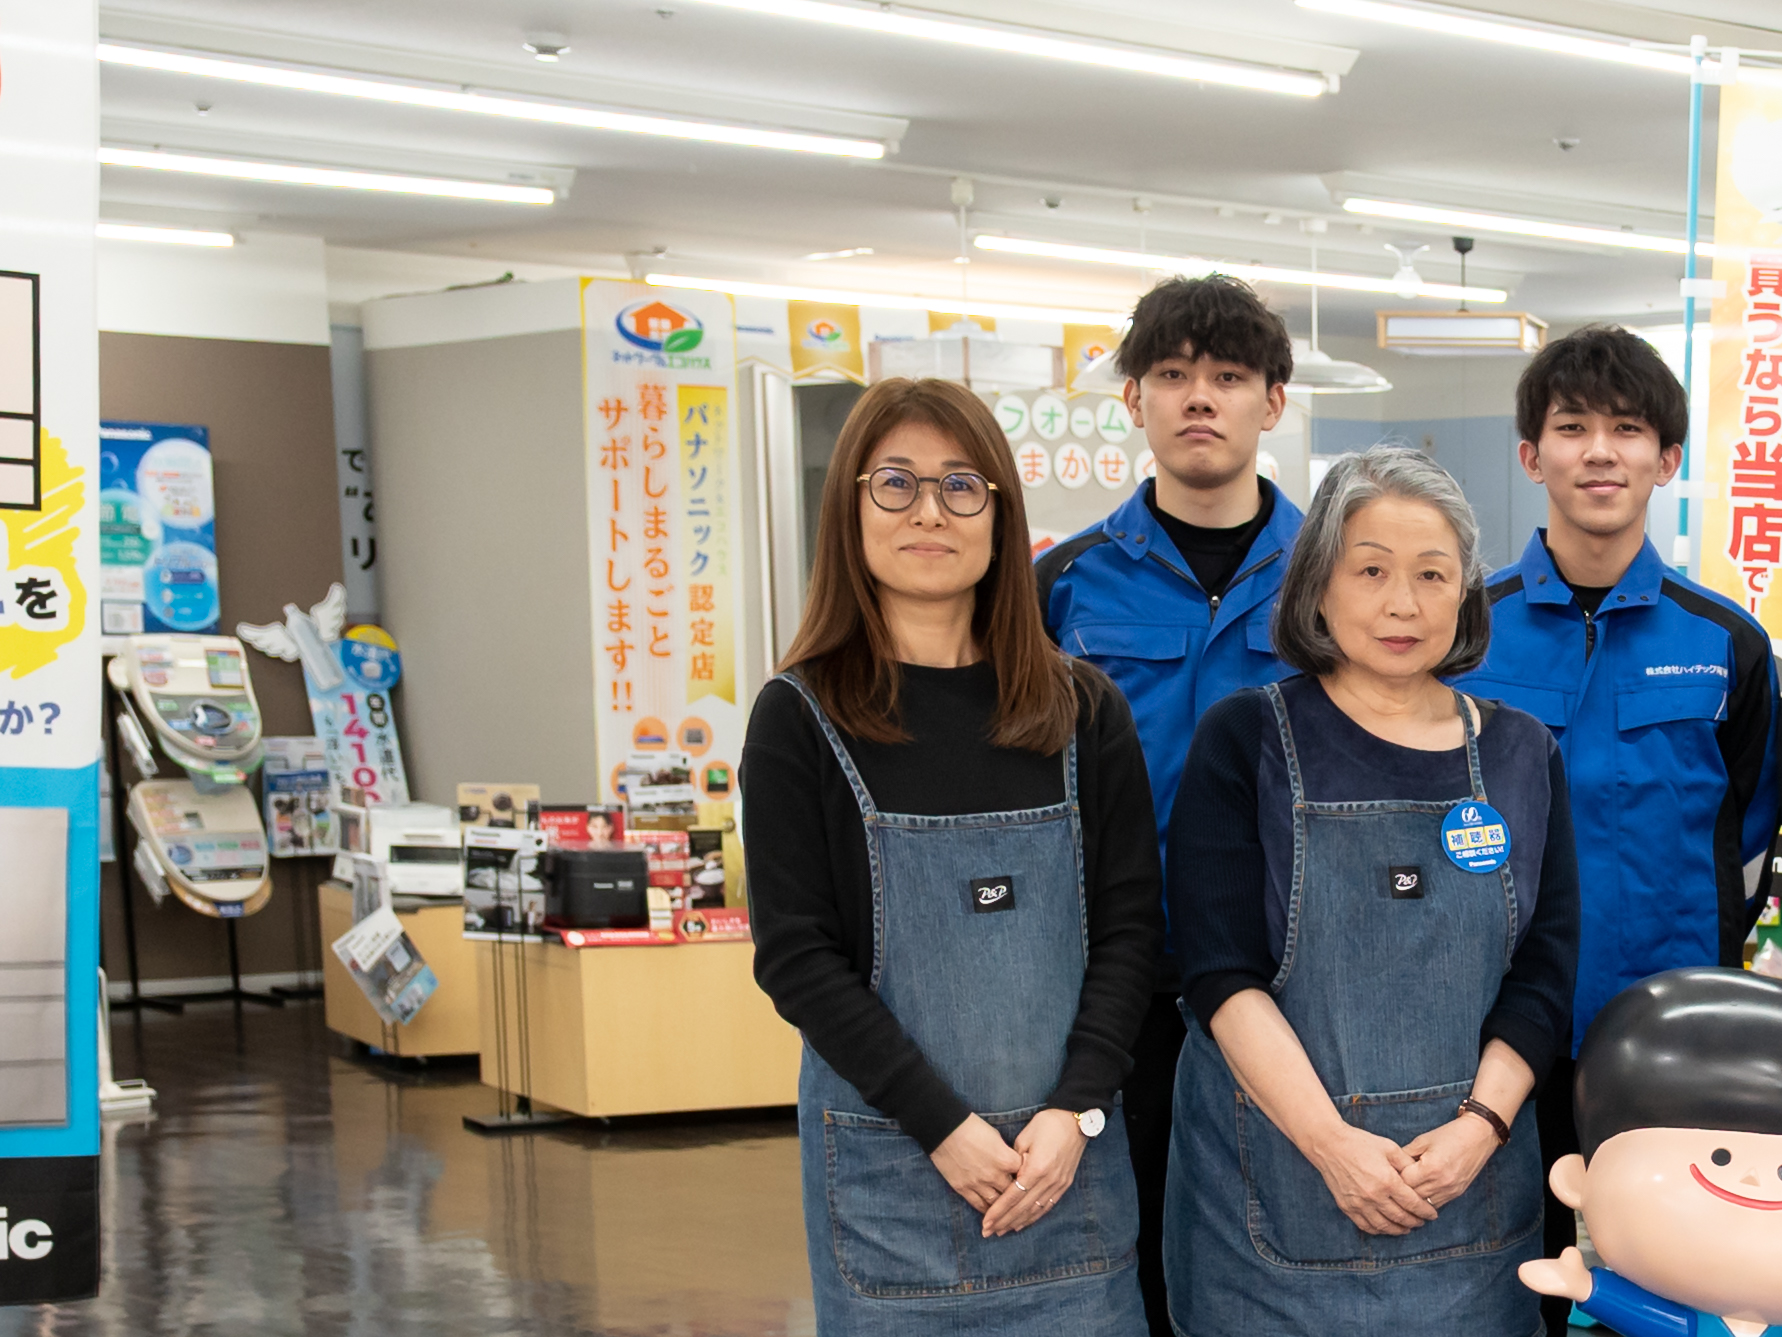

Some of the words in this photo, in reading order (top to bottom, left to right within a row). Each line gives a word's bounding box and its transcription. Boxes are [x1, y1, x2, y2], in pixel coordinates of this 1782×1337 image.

[15, 576, 59, 620] を
[597, 398, 636, 712] サポートします!!
[636, 382, 674, 659] 暮らしまるごと
